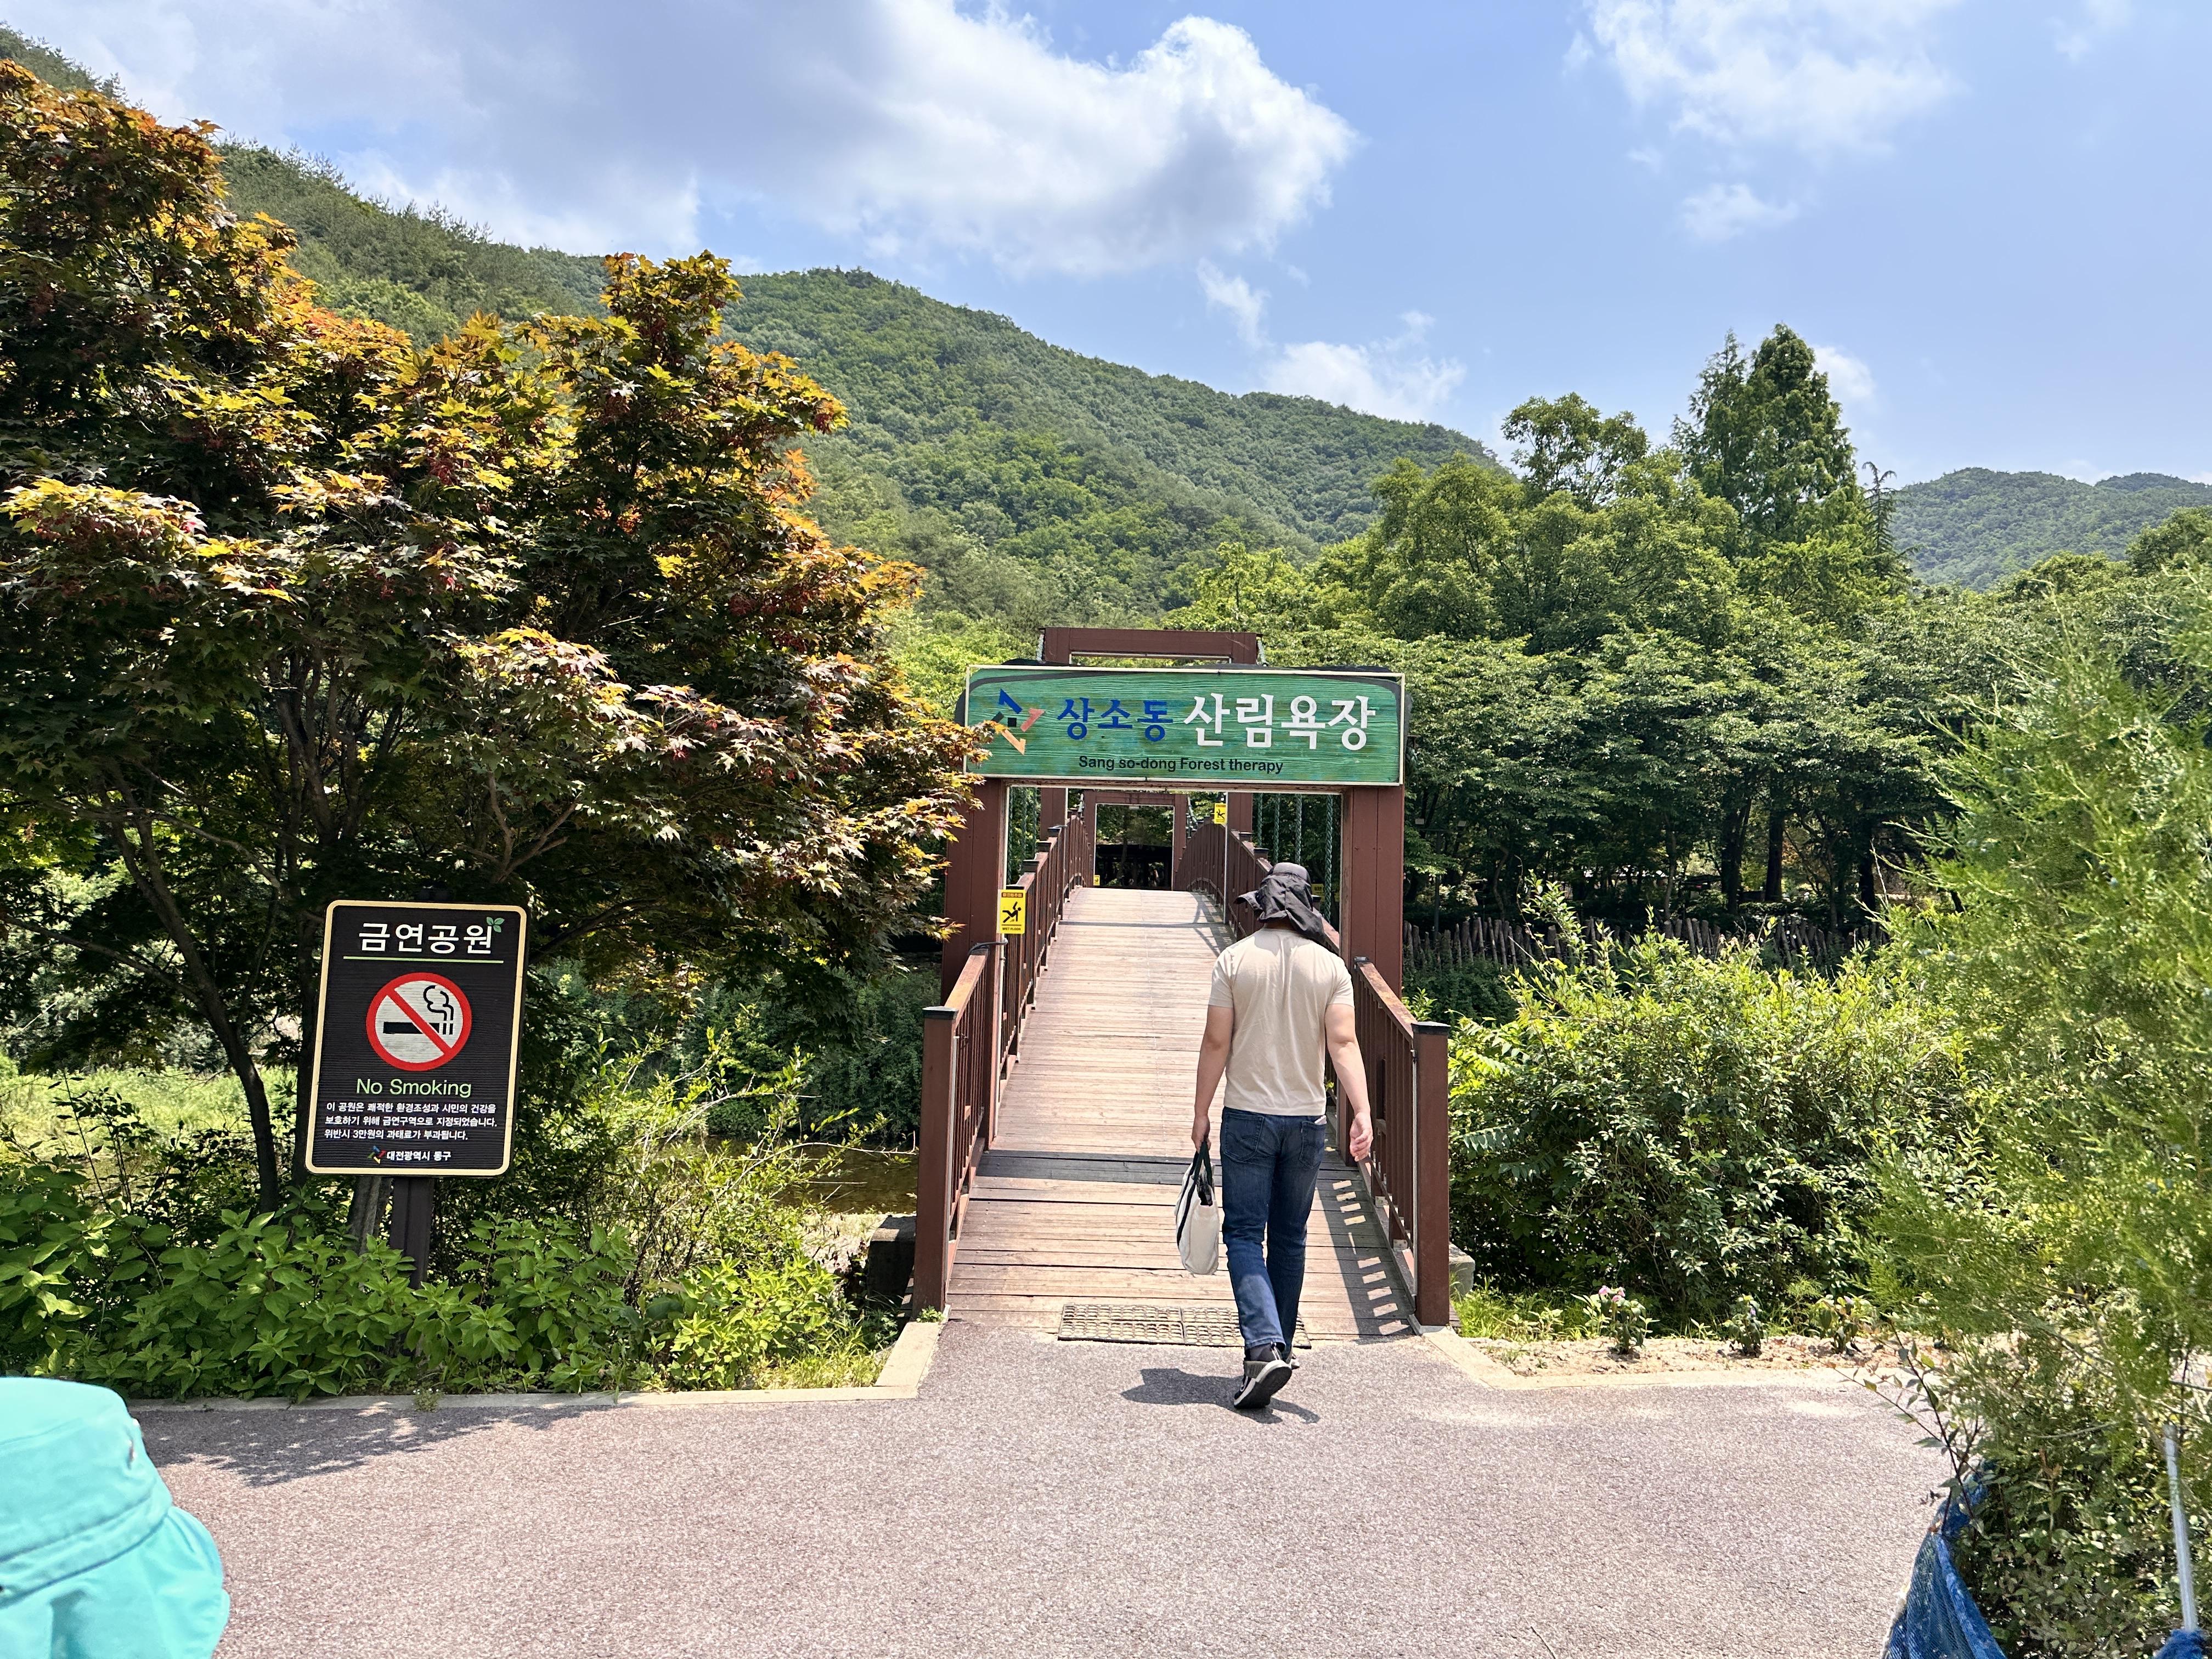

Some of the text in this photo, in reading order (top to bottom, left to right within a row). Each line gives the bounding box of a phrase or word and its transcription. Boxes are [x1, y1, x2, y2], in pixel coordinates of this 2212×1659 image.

[1057, 692, 1376, 751] 상소동 산림욕장
[1079, 755, 1283, 774] Sang so-dong Forest therapy
[359, 923, 492, 954] 금연공원
[356, 1078, 472, 1097] No Smoking
[326, 1102, 496, 1114] 이 공원은 쾌적한 환경조성과 시민의 건강을
[325, 1115, 497, 1127] 보호하기 위해 금연구역으로 지정되었습니다.
[324, 1129, 468, 1141] 위반시 3만원의 과태료가 부과됩니다.
[387, 1151, 452, 1161] 대전광역시 동구
